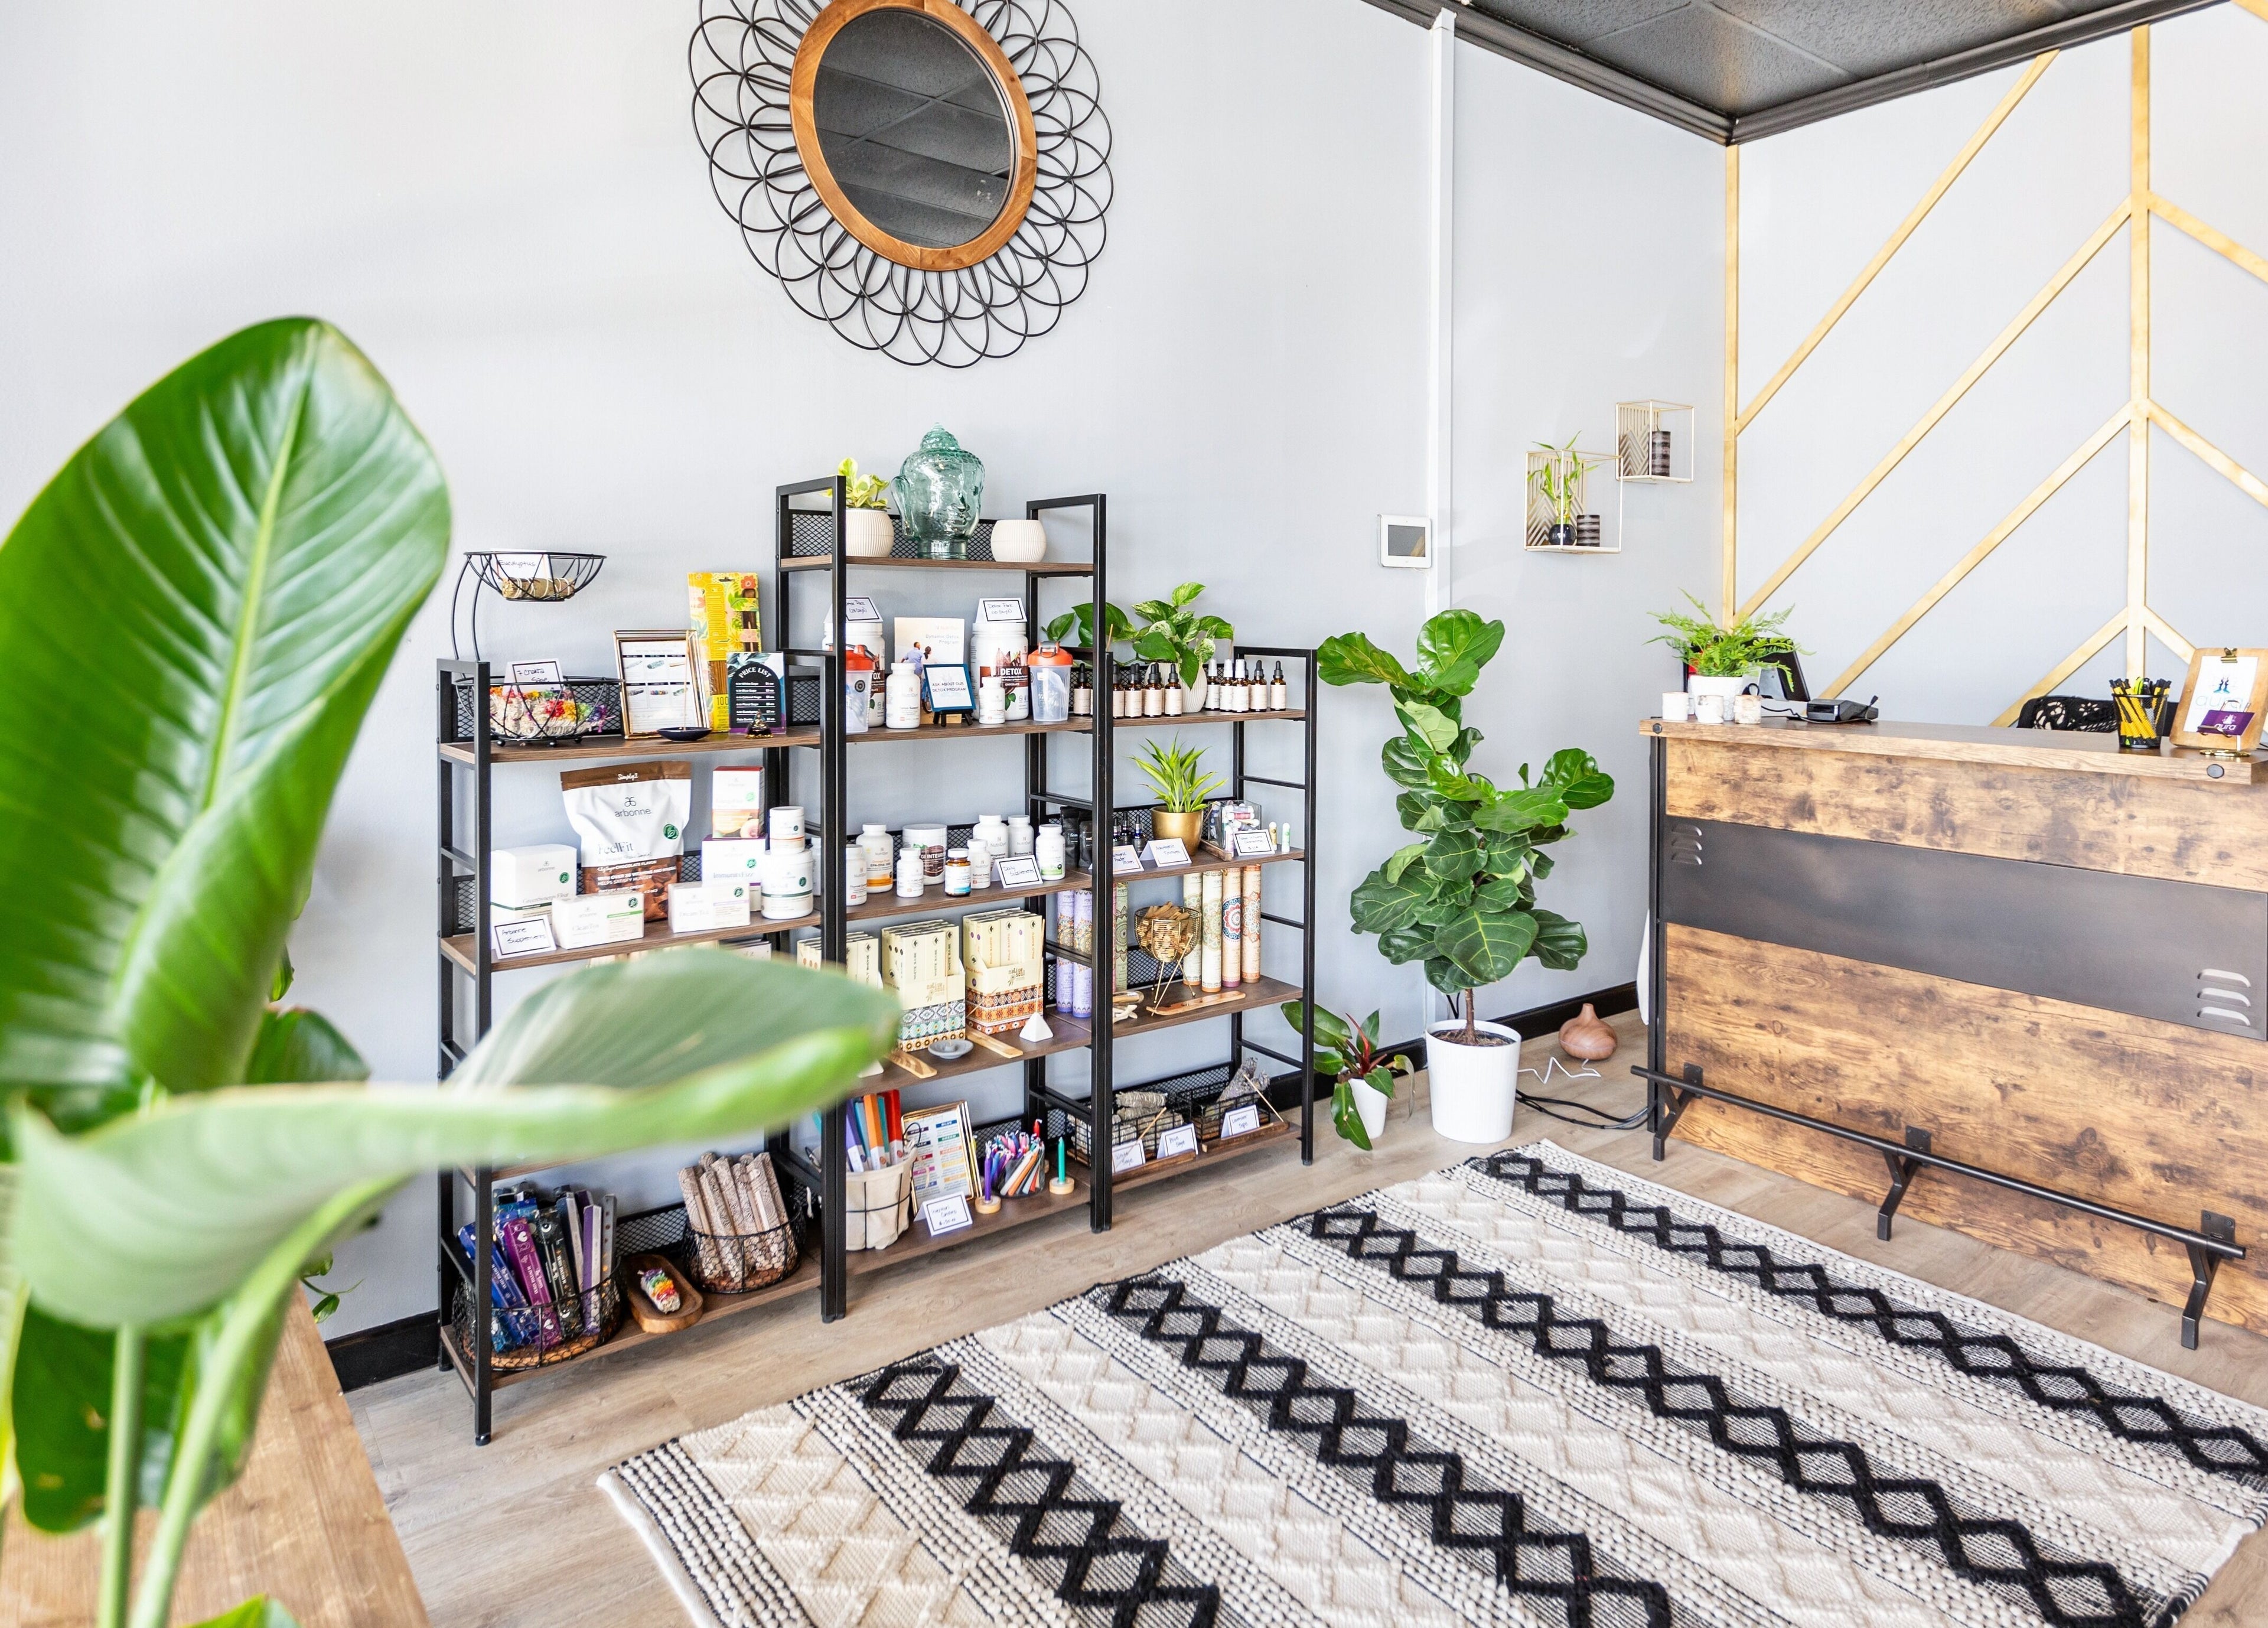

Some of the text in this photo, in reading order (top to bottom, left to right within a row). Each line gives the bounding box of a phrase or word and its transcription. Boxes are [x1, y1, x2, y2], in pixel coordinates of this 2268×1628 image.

[738, 667, 772, 678] PRICE LIST
[615, 808, 652, 817] arbonne
[598, 841, 634, 854] FeelFit
